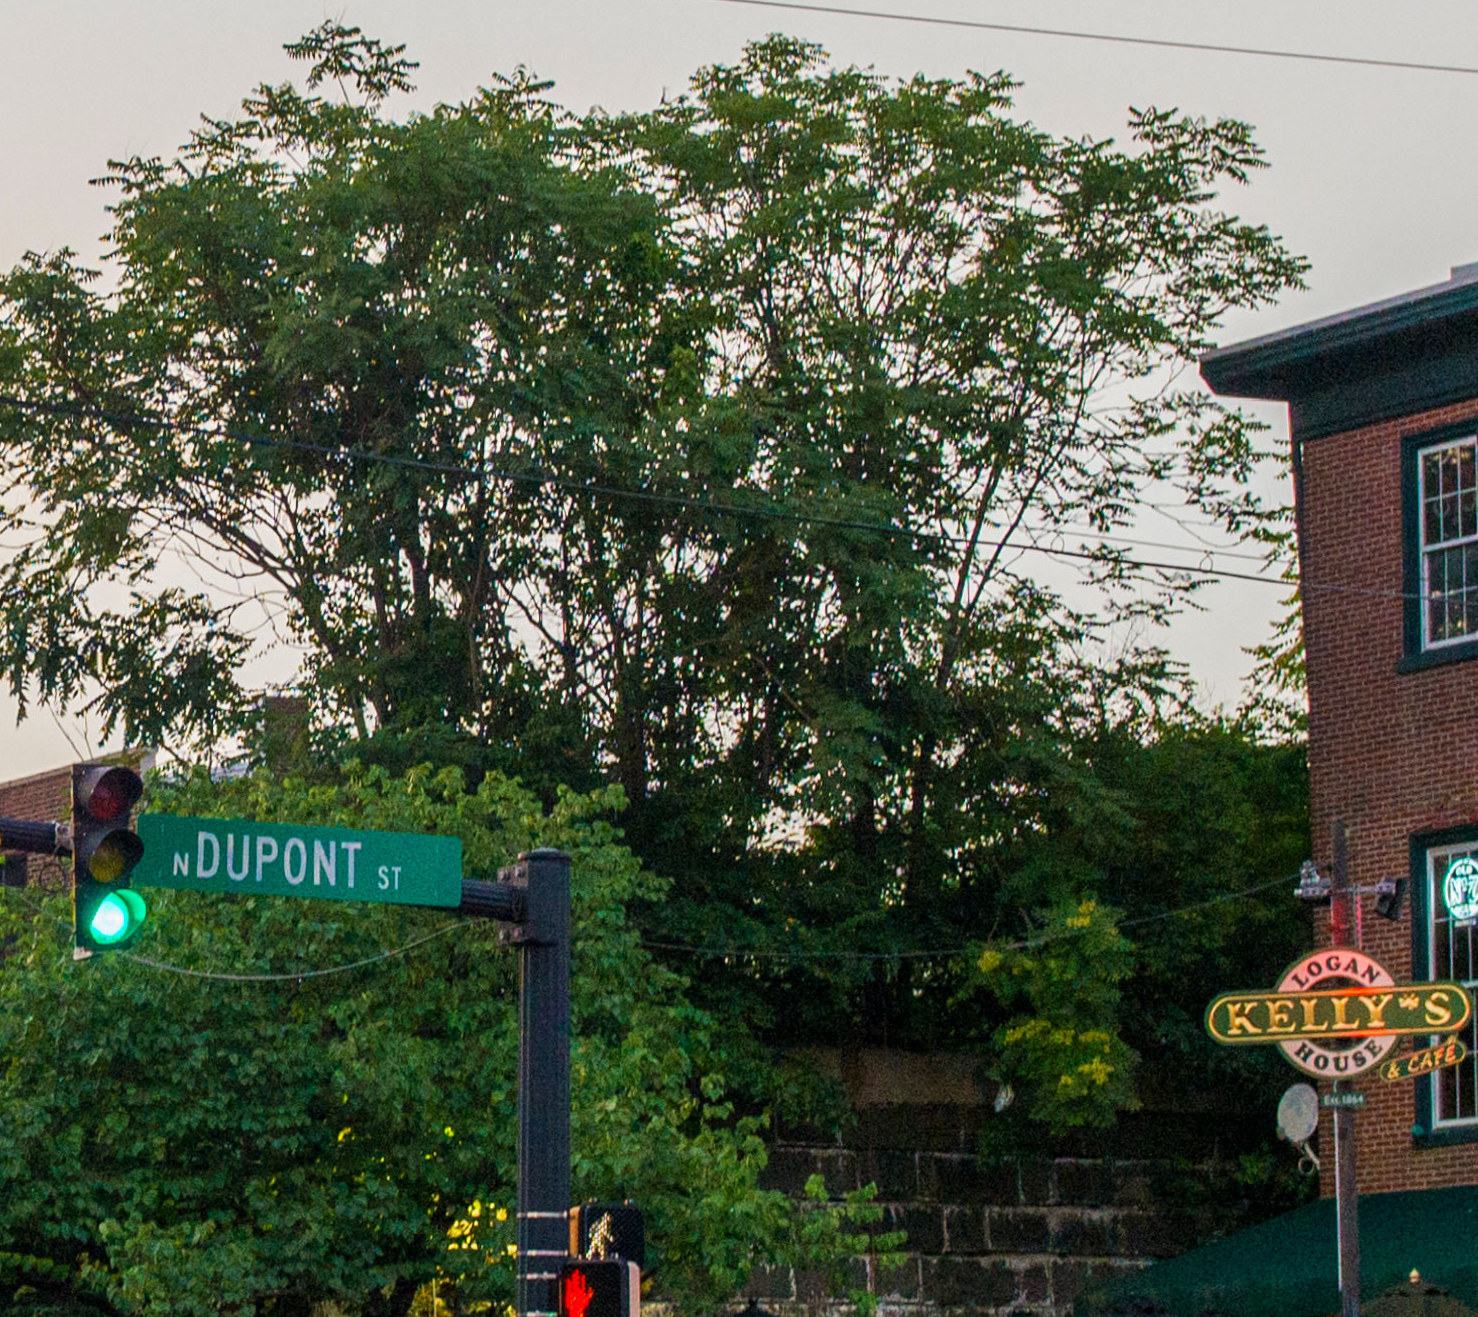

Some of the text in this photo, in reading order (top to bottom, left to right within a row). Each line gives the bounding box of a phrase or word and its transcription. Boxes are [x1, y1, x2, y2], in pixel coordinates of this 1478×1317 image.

[173, 831, 402, 891] N DUPONT ST
[1292, 955, 1381, 988] LOGAN
[1226, 991, 1453, 1035] KELLY'S
[1294, 1039, 1383, 1072] HOUSE
